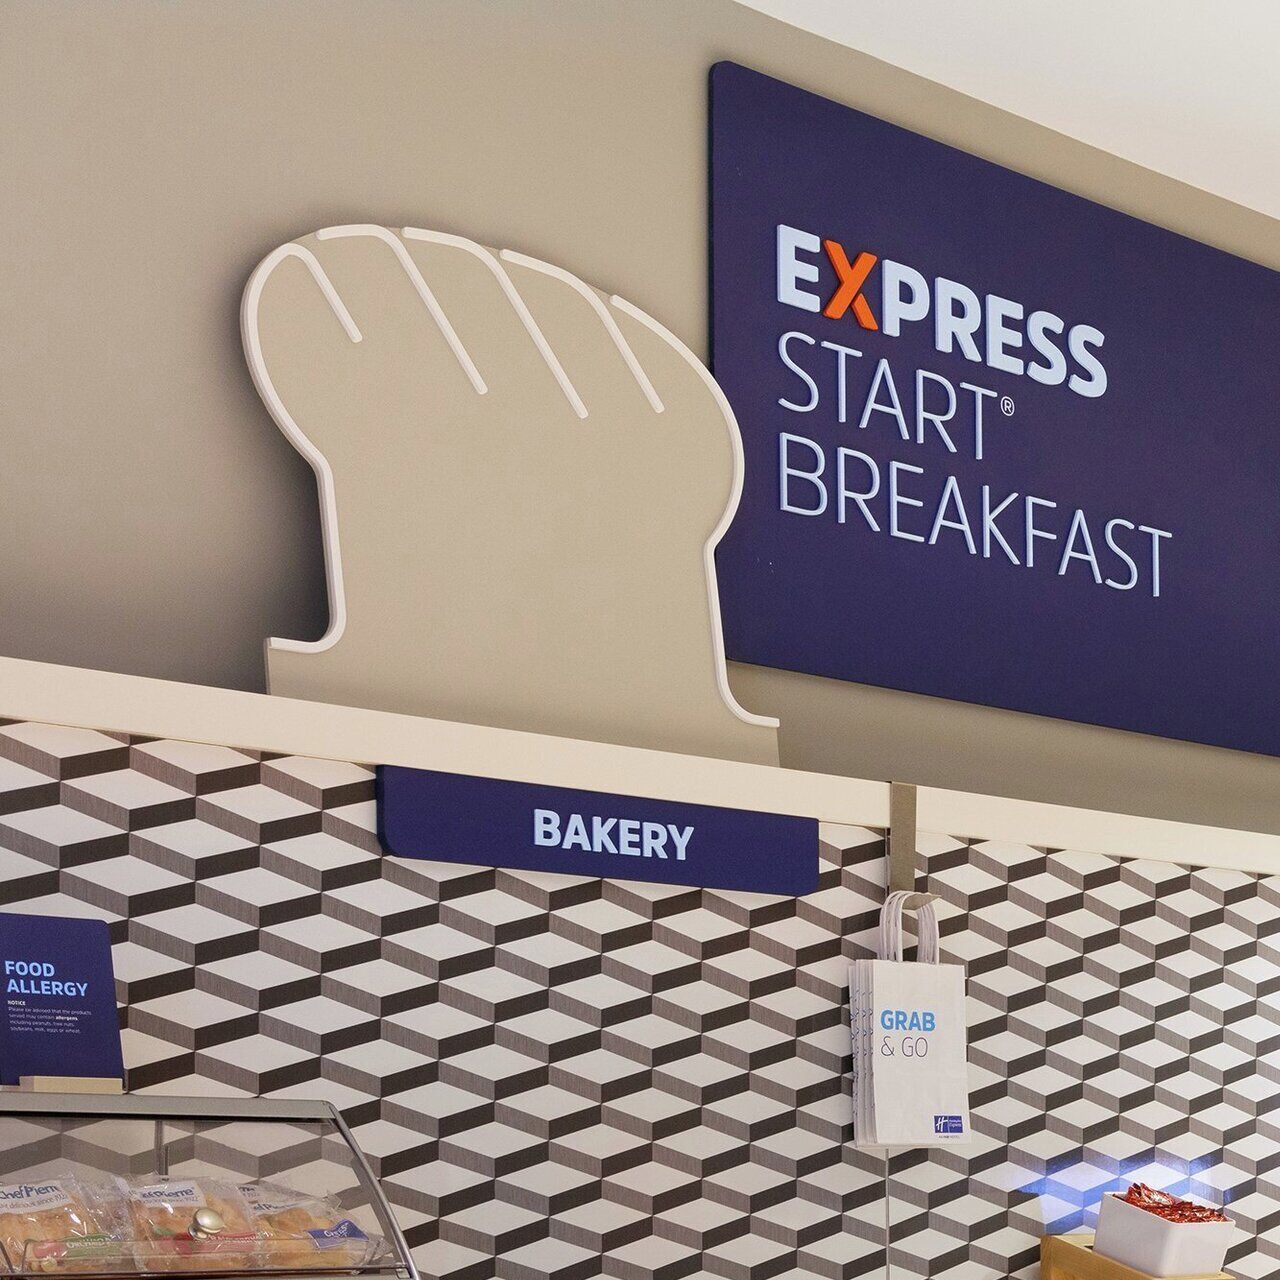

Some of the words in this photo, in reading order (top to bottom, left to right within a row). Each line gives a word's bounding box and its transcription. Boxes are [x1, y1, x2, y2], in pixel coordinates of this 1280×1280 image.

[776, 224, 1109, 398] EXPRESS
[780, 432, 1173, 597] BREAKFAST
[534, 808, 695, 861] BAKERY
[5, 960, 55, 977] FOOD
[7, 979, 88, 997] ALLERGY
[880, 1009, 936, 1032] GRAB
[880, 1035, 895, 1056] &
[901, 1036, 928, 1057] GO
